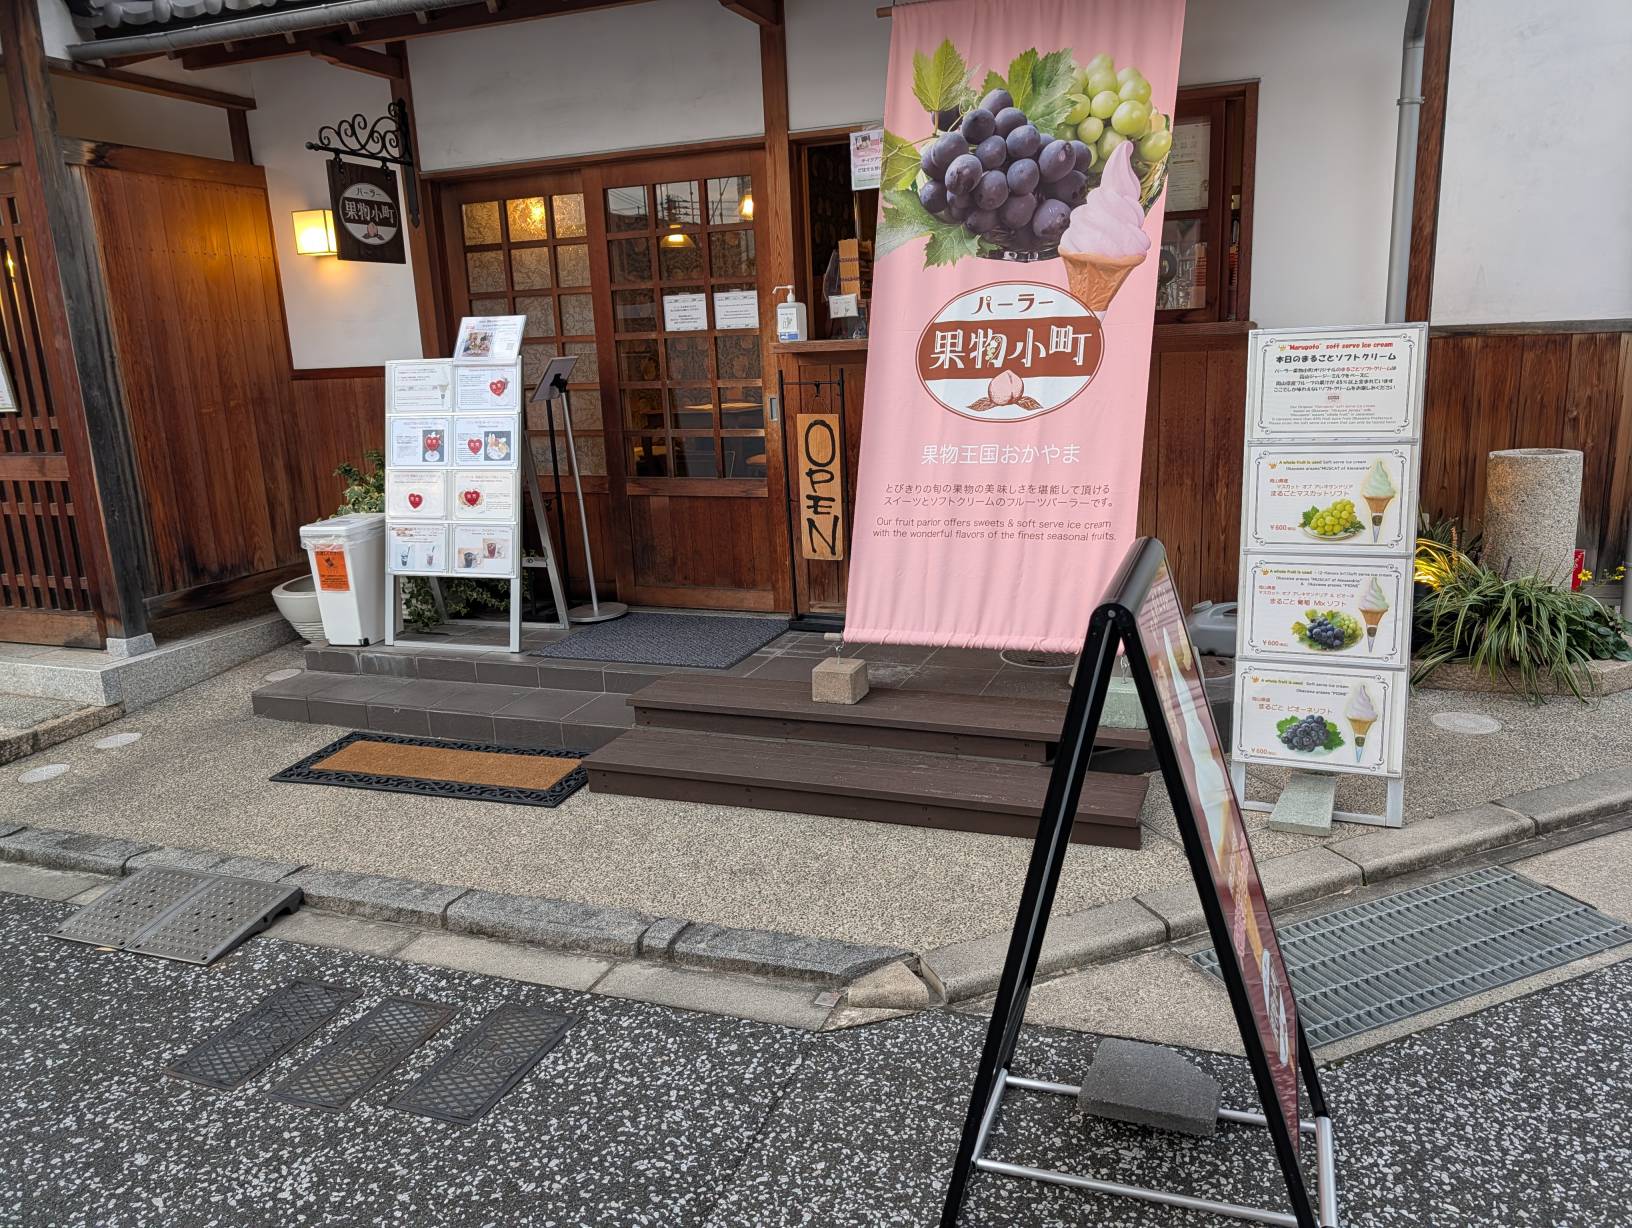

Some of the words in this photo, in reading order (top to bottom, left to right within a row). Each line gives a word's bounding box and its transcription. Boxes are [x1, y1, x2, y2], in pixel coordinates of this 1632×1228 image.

[354, 187, 383, 198] パーラー
[344, 200, 395, 224] 果物小町
[971, 292, 1055, 315] パーラー
[929, 324, 1093, 370] 果物小町
[1276, 353, 1396, 364] 本日のまるごとソフトクリーム
[921, 443, 1081, 466] 果物王国おかやま
[804, 419, 840, 556] OPEN
[885, 483, 1110, 496] とびきりの旬の果物の美味しさを堪能して頂ける
[877, 517, 892, 526] Our
[895, 517, 914, 526] fruit
[917, 518, 941, 528] parlor
[944, 517, 971, 527] offers
[974, 519, 1004, 528] sweets
[1007, 518, 1014, 528] &
[1017, 519, 1036, 528] soft
[1039, 520, 1064, 529] serve
[1067, 519, 1081, 529] ice
[1084, 520, 1112, 530] cream
[873, 528, 890, 537] with
[893, 529, 908, 538] the
[910, 529, 953, 538] wonderful
[955, 530, 985, 539] flavors
[987, 530, 998, 539] of
[1001, 530, 1015, 539] the
[1017, 531, 1044, 540] finest
[1047, 532, 1089, 541] seasonal
[1091, 532, 1117, 541] fruits.
[1269, 598, 1296, 606] まるごと
[1327, 600, 1347, 608] ソフト
[1258, 703, 1284, 712] まるごと
